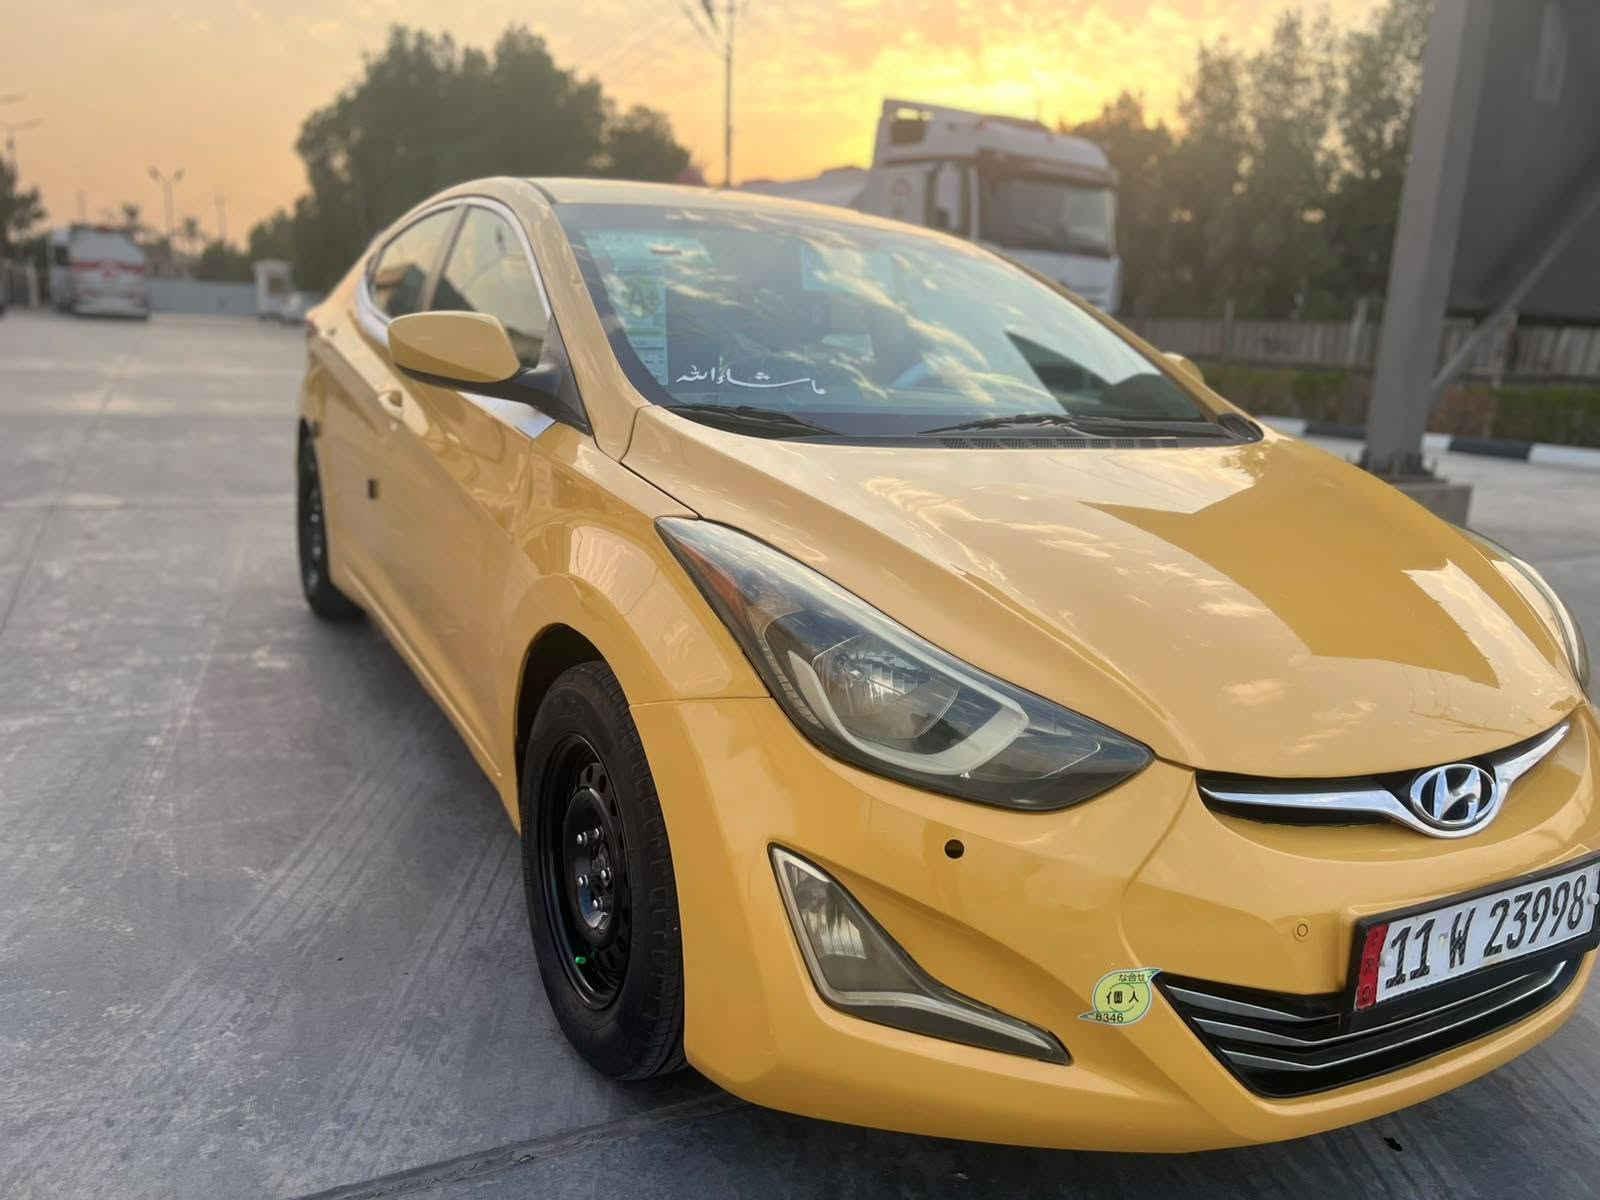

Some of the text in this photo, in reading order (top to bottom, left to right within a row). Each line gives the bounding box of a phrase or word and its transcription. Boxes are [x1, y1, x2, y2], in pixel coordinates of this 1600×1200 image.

[1385, 918, 1436, 989] 11
[1483, 874, 1588, 958] 23998
[1095, 1013, 1124, 1022] 8346
